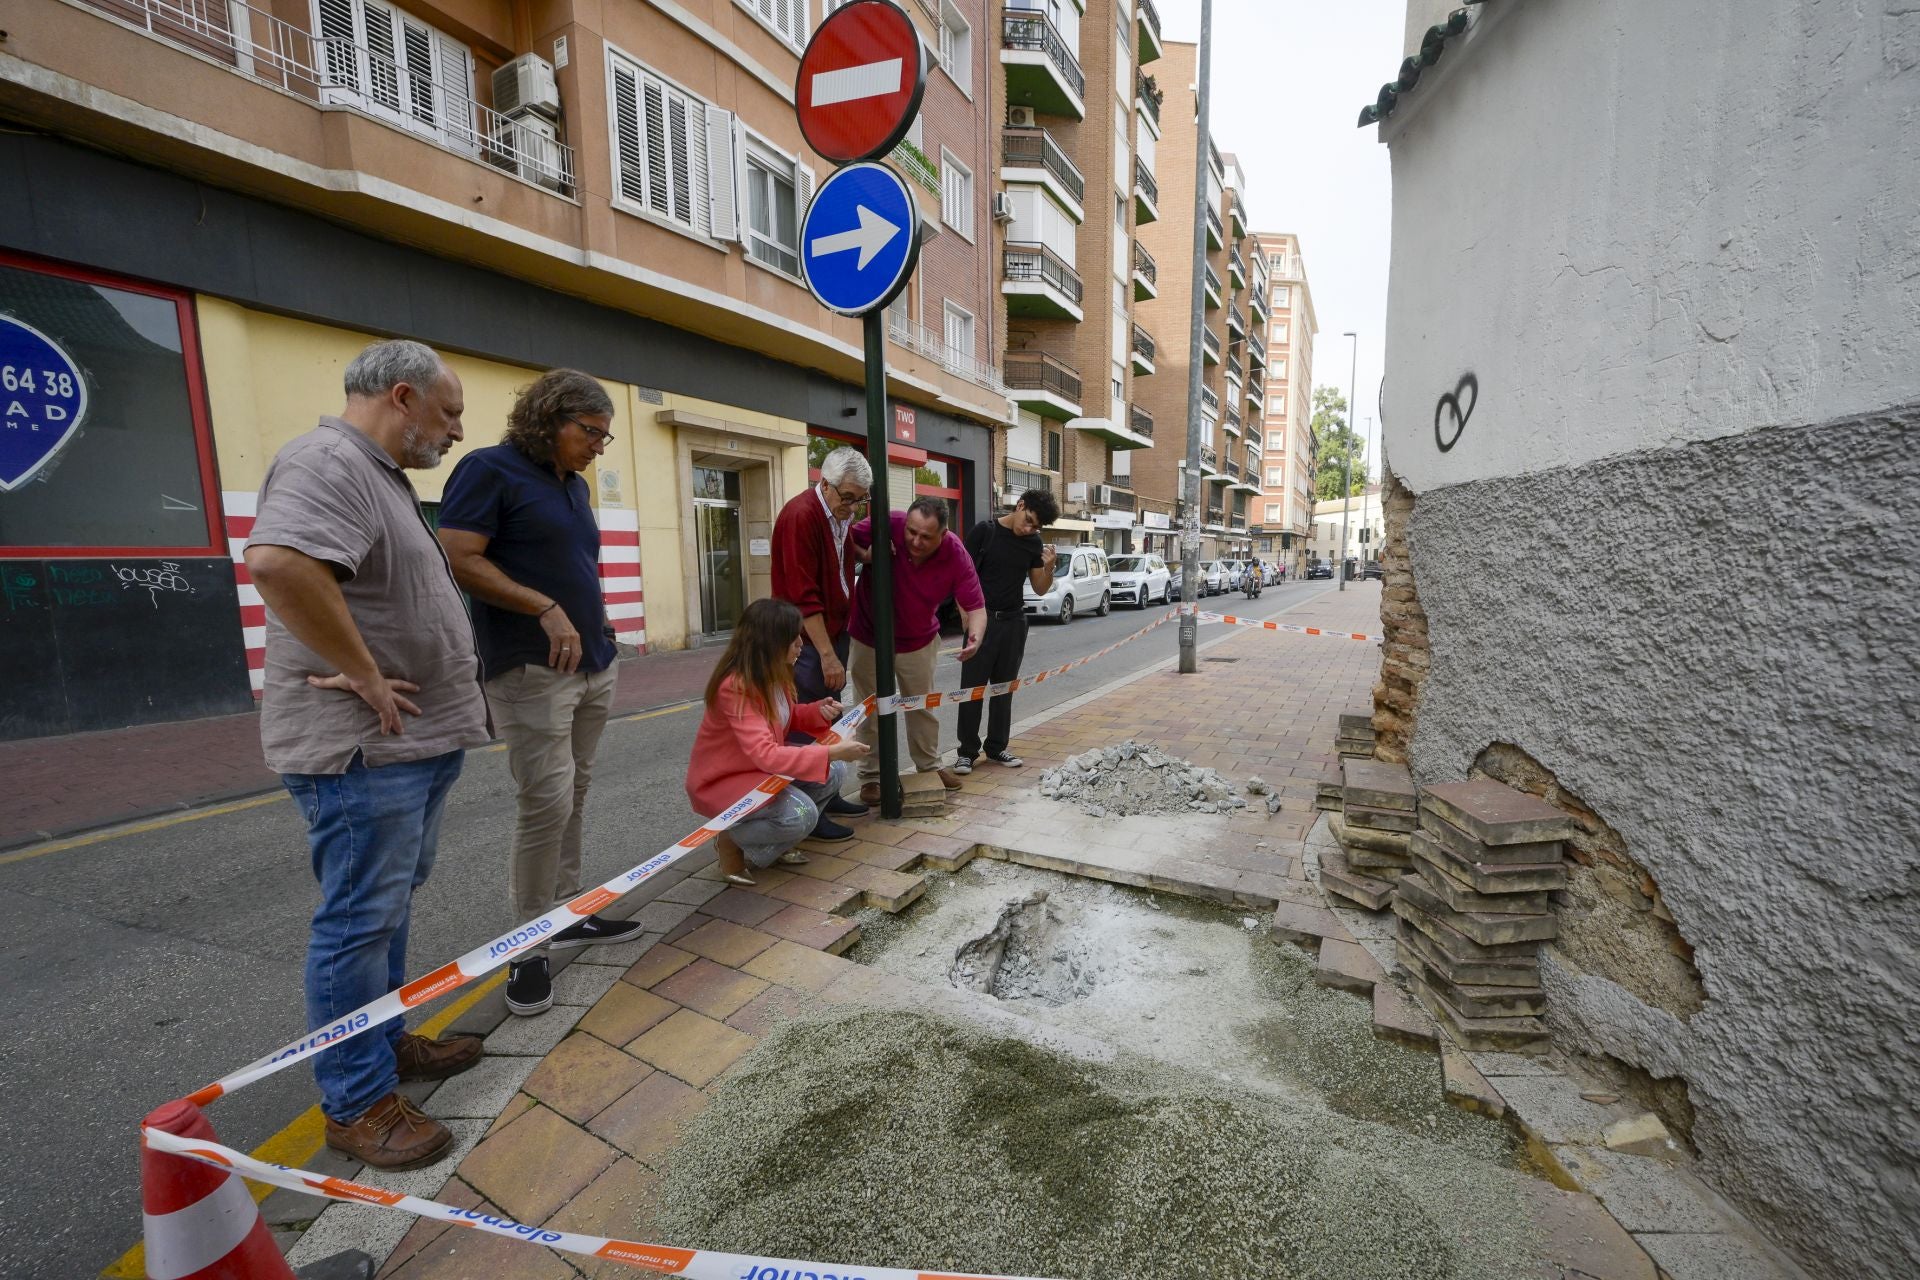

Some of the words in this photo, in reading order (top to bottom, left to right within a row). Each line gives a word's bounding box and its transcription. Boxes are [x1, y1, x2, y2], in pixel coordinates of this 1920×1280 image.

[2, 365, 36, 394] 64
[42, 370, 74, 399] 38
[896, 409, 915, 425] TWO
[720, 797, 753, 821] elecnor
[626, 854, 671, 881] elecnor
[489, 919, 553, 958] elecnor
[606, 1248, 662, 1264] molestias
[662, 1258, 680, 1268] las
